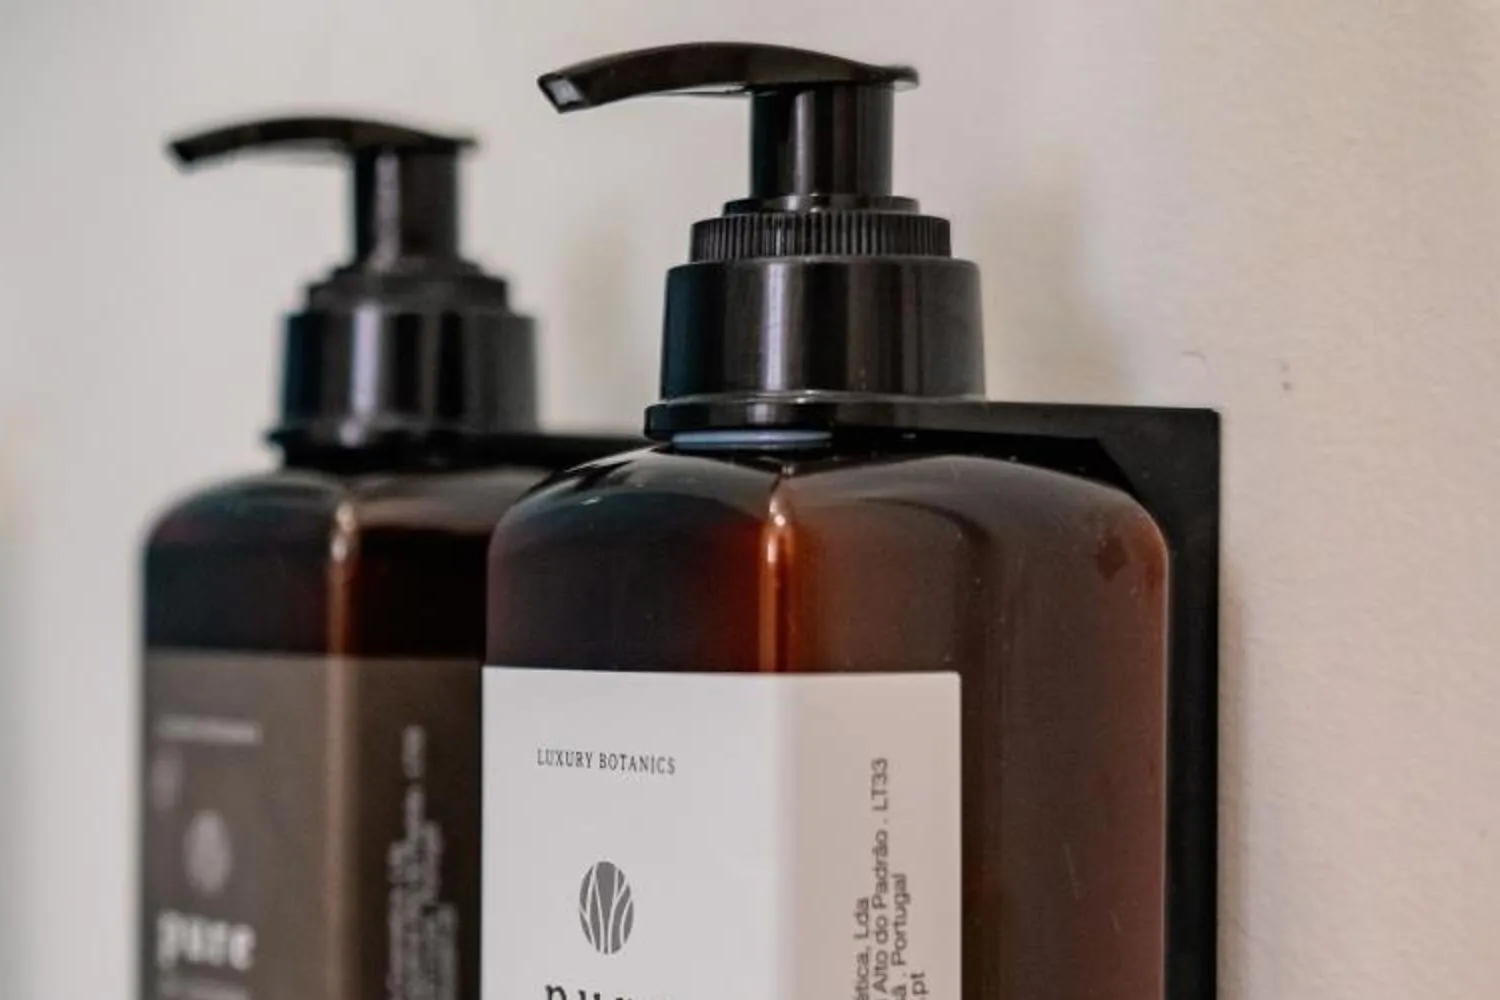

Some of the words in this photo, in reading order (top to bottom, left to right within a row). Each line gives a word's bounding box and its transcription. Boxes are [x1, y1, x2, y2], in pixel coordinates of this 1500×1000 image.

[537, 748, 593, 769] LUXURY
[599, 752, 676, 775] BOTANICS
[871, 757, 889, 812] LT33
[852, 897, 870, 940] Lda
[871, 915, 889, 945] do
[890, 873, 911, 967] Portugal
[871, 950, 888, 994] Alto
